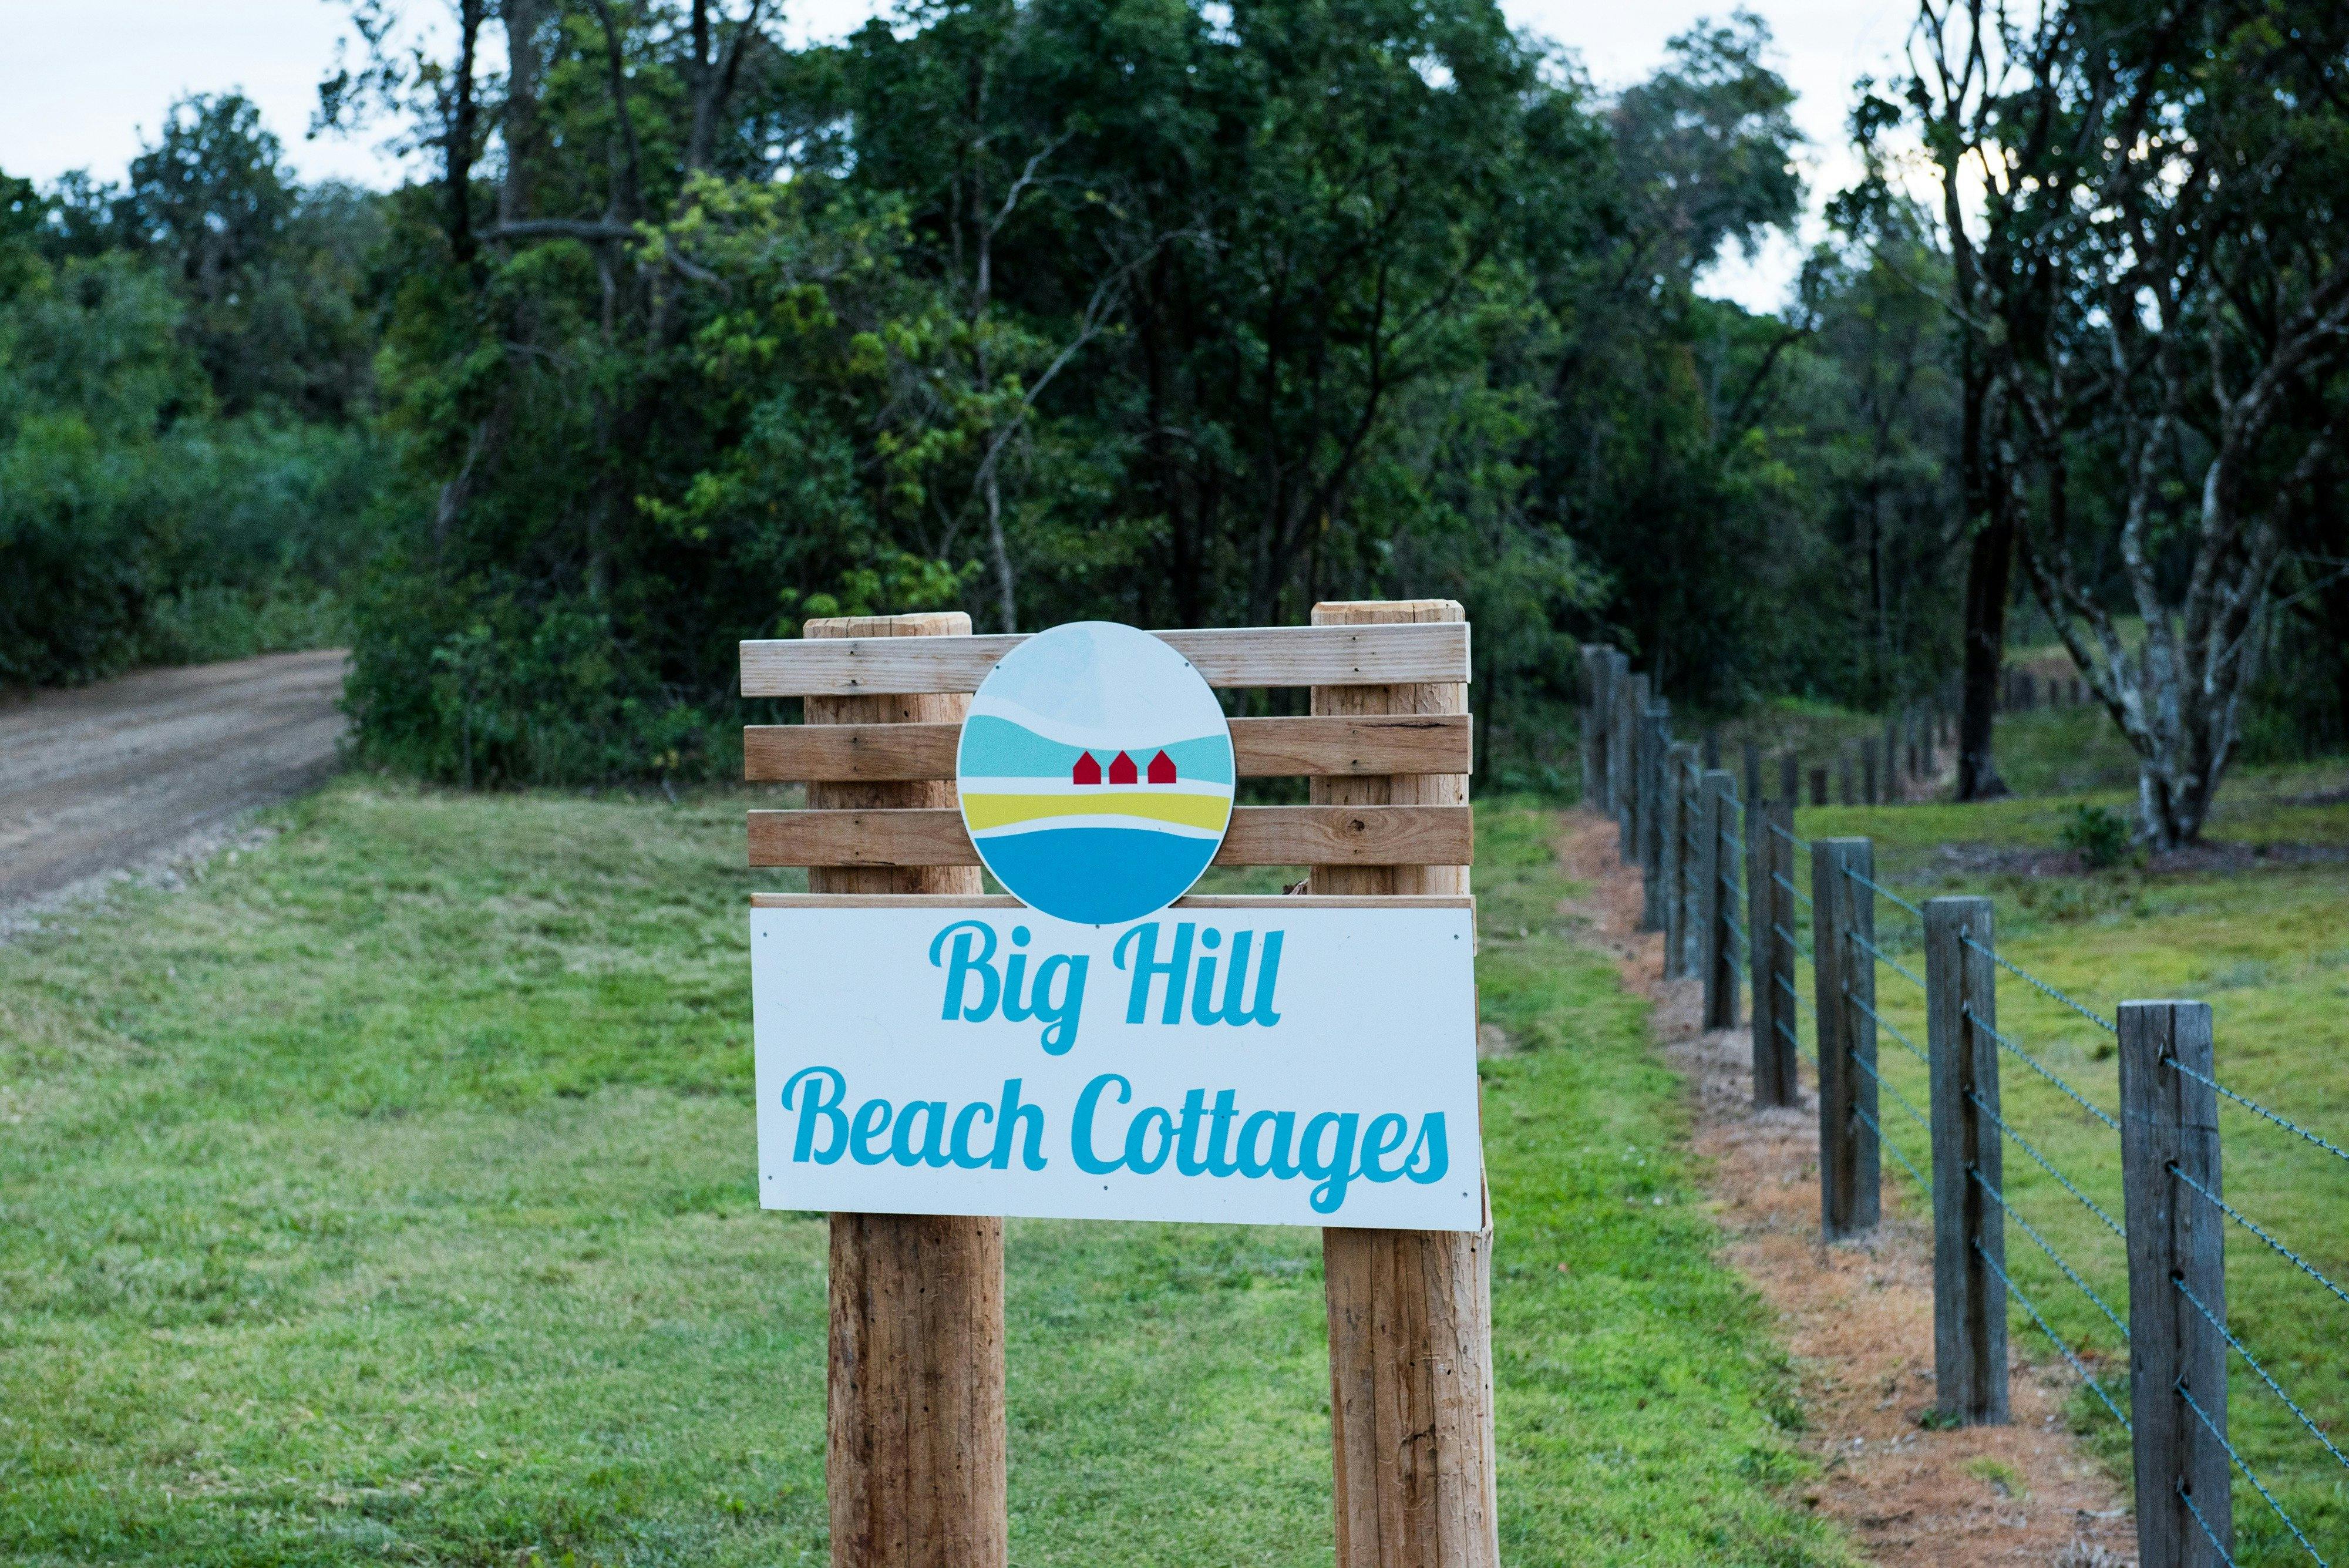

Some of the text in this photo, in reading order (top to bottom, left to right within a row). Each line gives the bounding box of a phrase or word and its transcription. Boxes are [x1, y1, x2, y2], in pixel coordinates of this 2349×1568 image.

[928, 919, 1285, 1058] Big Hill
[780, 1065, 1450, 1216] Beach Cottages
